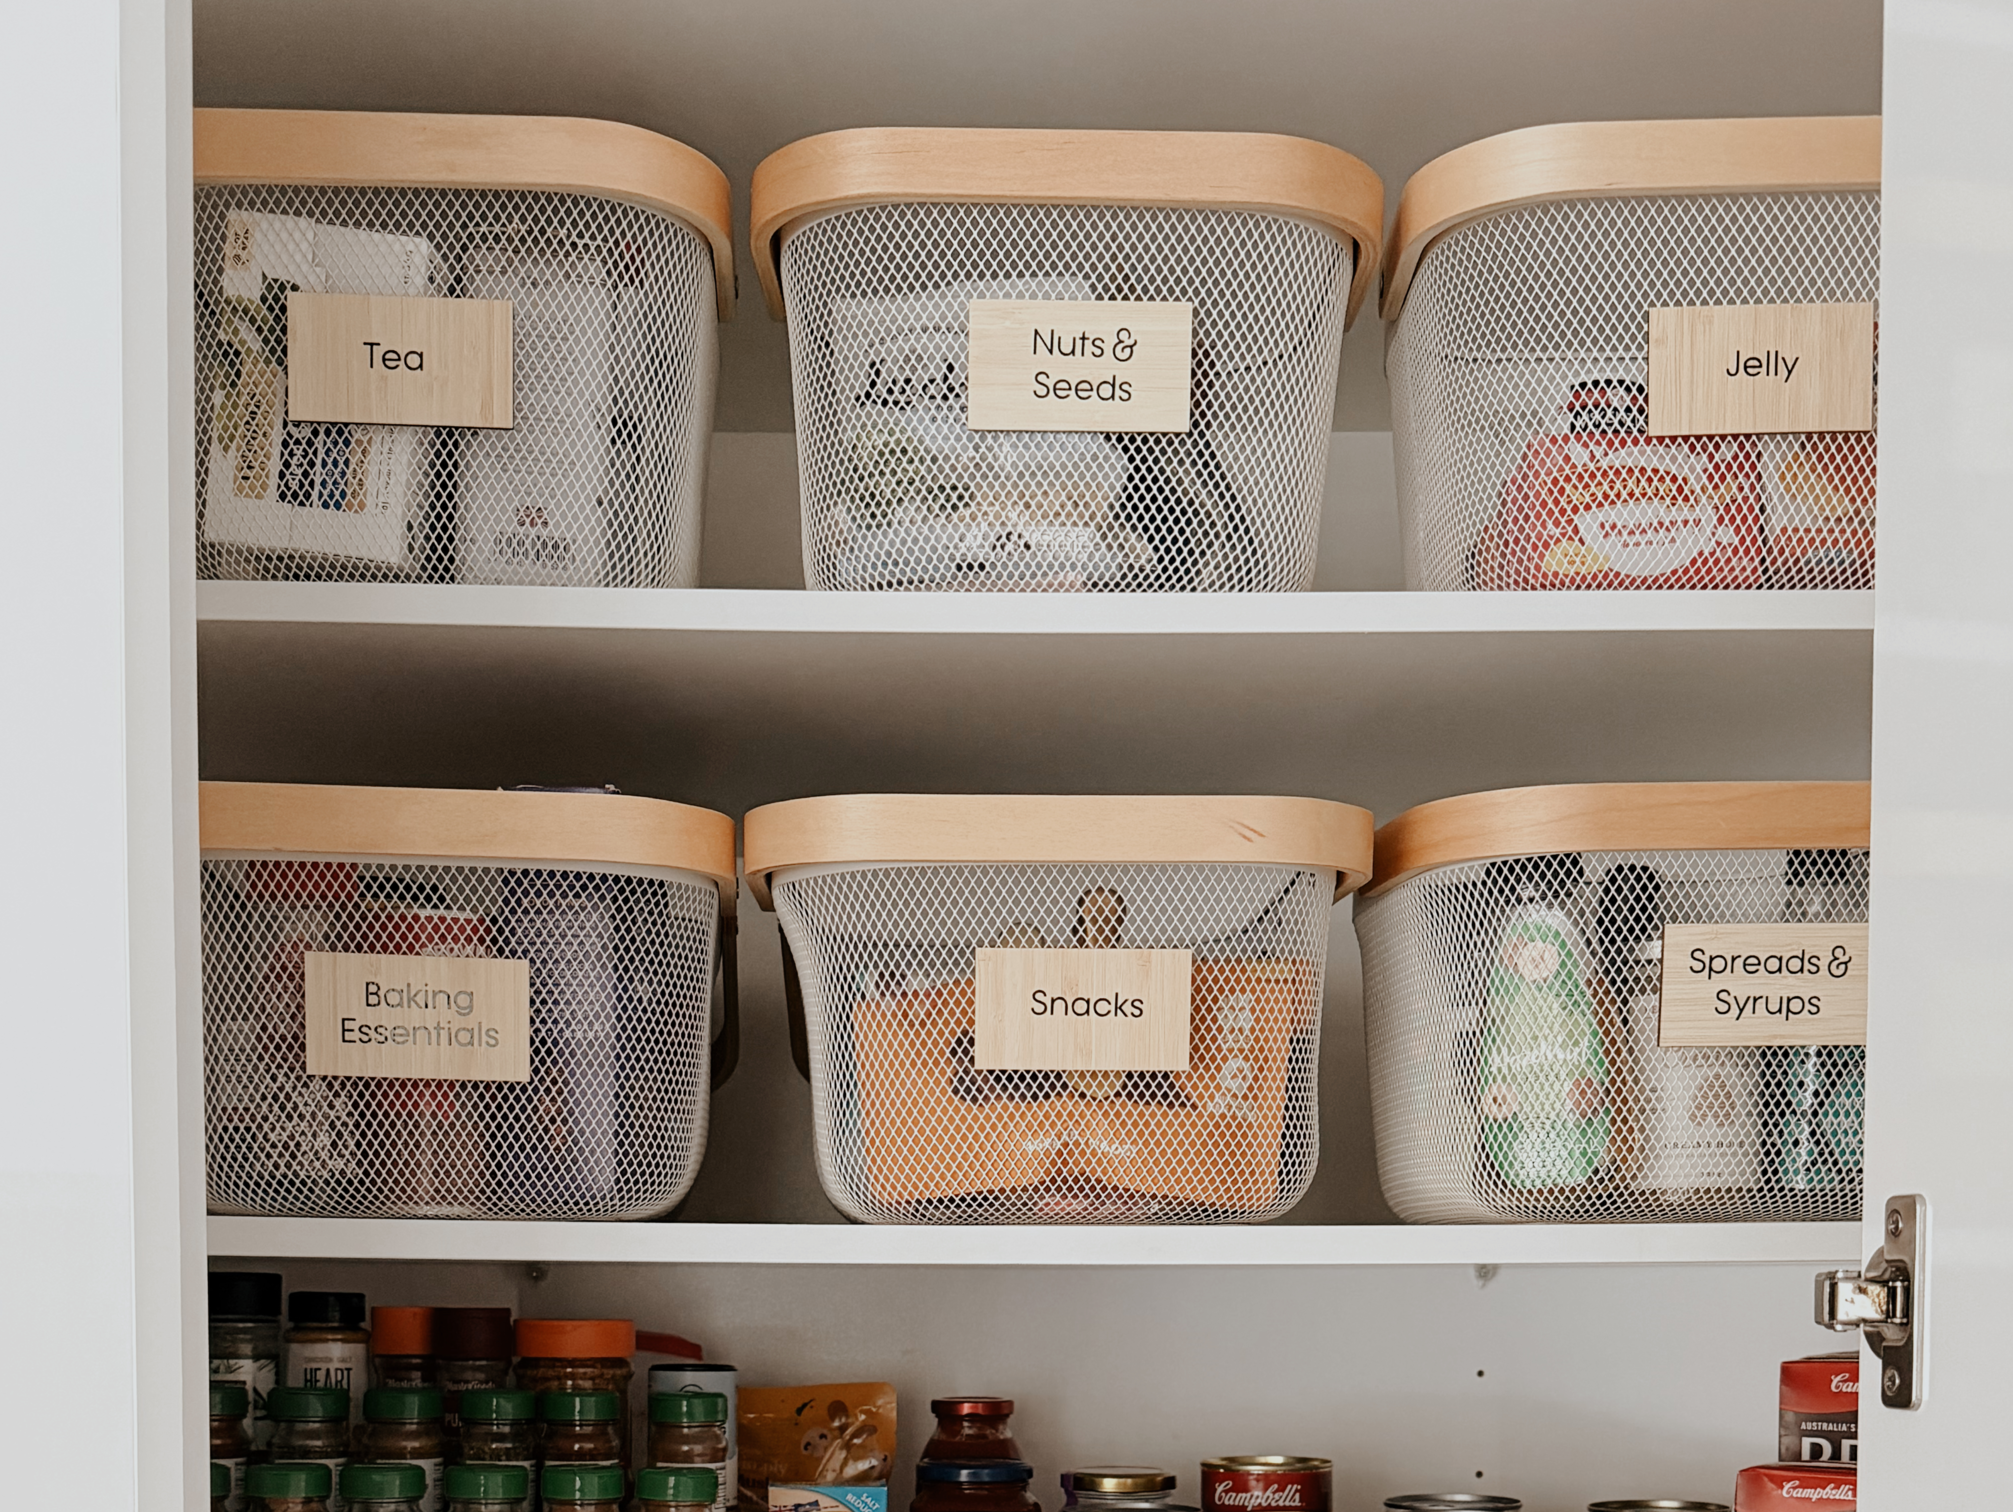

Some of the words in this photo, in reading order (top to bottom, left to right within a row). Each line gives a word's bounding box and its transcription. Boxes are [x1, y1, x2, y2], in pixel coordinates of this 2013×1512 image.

[363, 342, 424, 372] Tea
[1033, 328, 1105, 358] Nuts
[1112, 327, 1138, 363] &
[1726, 350, 1800, 382] Jelly
[1033, 371, 1132, 402] Seeds
[1689, 947, 1821, 980] Spreads
[1827, 945, 1852, 978] &
[365, 981, 474, 1016] Baking
[1030, 989, 1144, 1018] Snacks
[1714, 989, 1821, 1021] Syrups
[341, 1017, 500, 1048] Essentials
[304, 1367, 353, 1390] HEART
[444, 1412, 462, 1428] PU
[1800, 1421, 1856, 1432] AUSTRALIA'S
[860, 1492, 881, 1511] SALT
[1214, 1480, 1302, 1511] Campbell's
[1782, 1480, 1857, 1503] Campbell's
